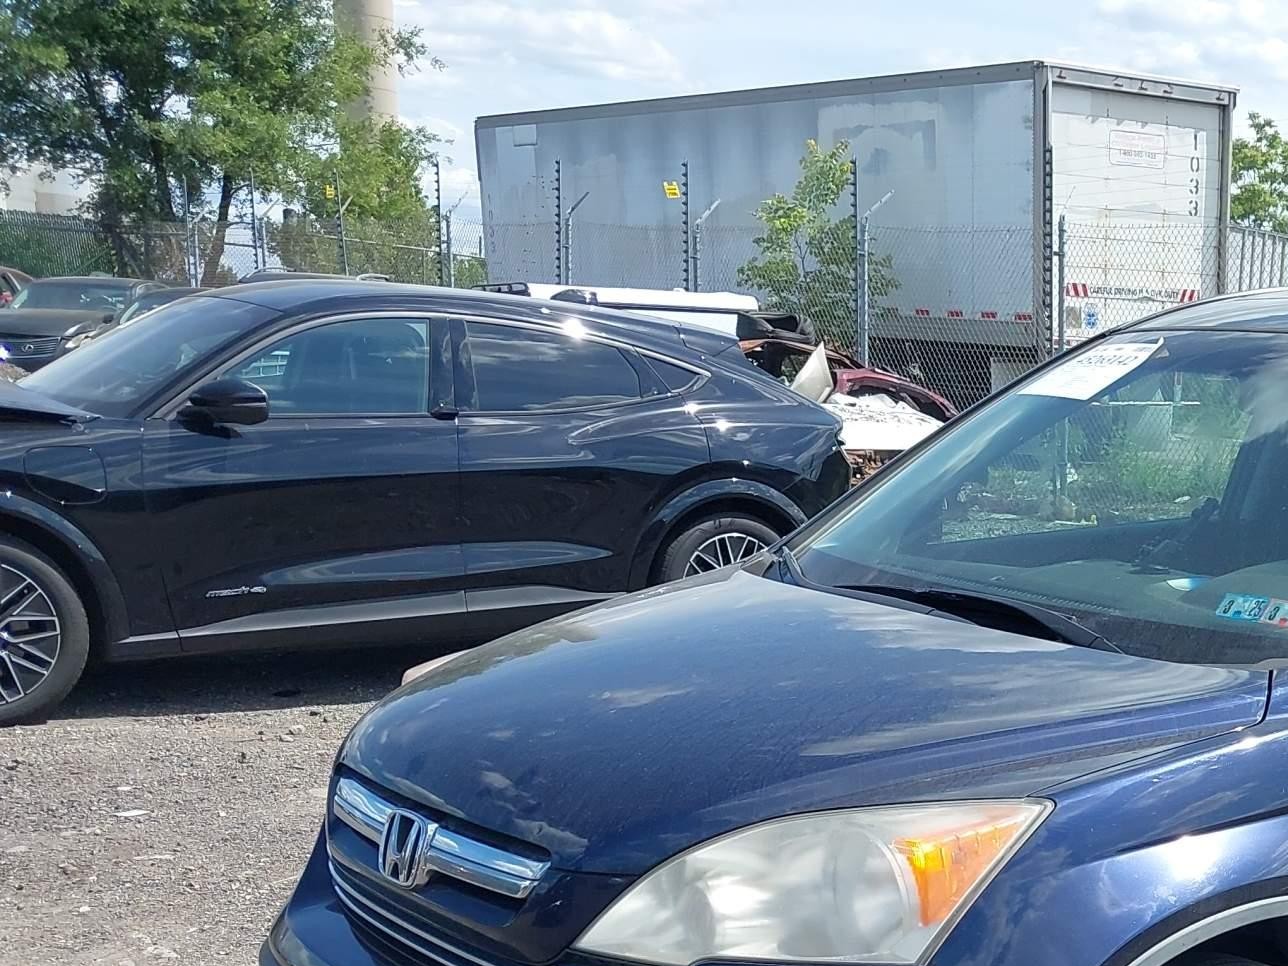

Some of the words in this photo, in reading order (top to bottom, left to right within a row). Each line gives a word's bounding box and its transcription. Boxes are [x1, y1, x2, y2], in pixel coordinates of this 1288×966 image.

[1223, 600, 1235, 614] 3
[1247, 600, 1266, 617] 25
[1268, 606, 1280, 621] 3
